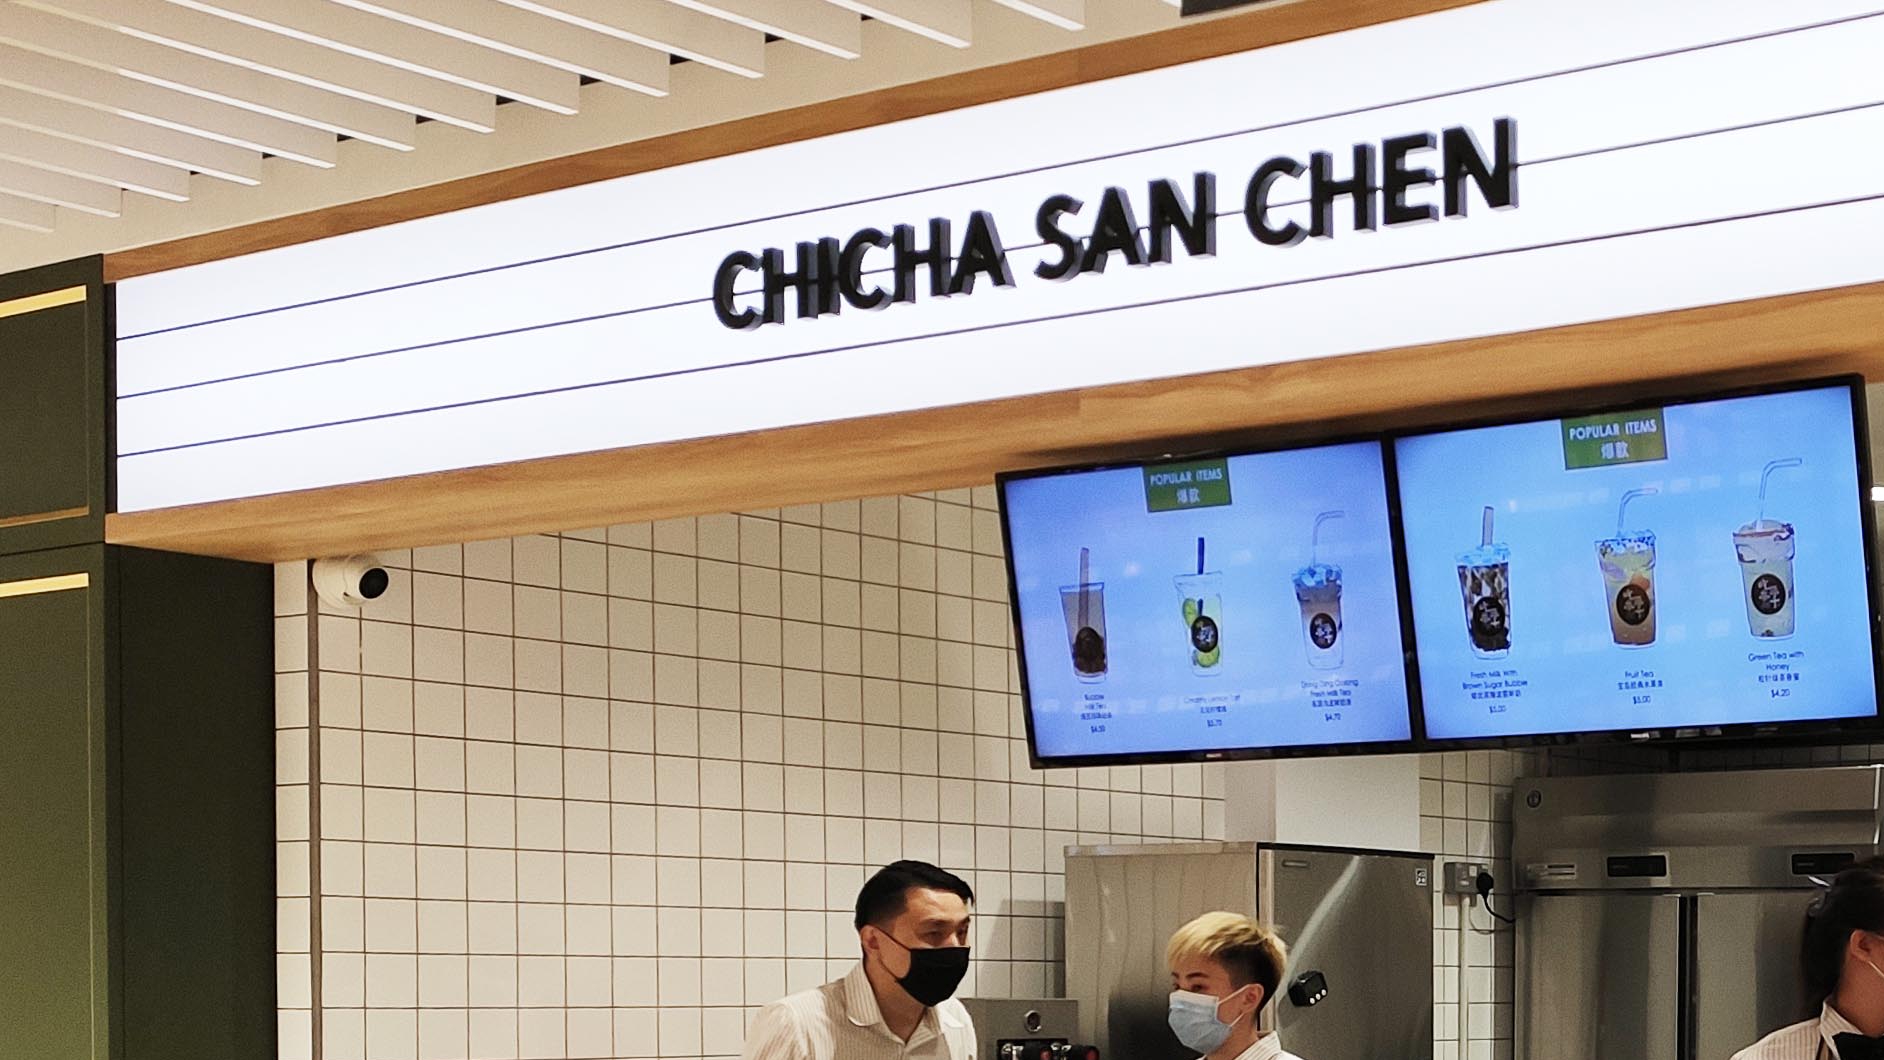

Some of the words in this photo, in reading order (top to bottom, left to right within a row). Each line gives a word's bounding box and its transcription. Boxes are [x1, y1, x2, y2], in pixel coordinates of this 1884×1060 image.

[712, 210, 1016, 331] CHICHA
[1034, 171, 1219, 281] SAN
[1244, 116, 1520, 246] CHEN
[1569, 423, 1620, 440] POPULAR
[1625, 419, 1657, 435] ITEMS
[1150, 471, 1192, 486] POPULAR
[1195, 468, 1223, 481] ITEMS
